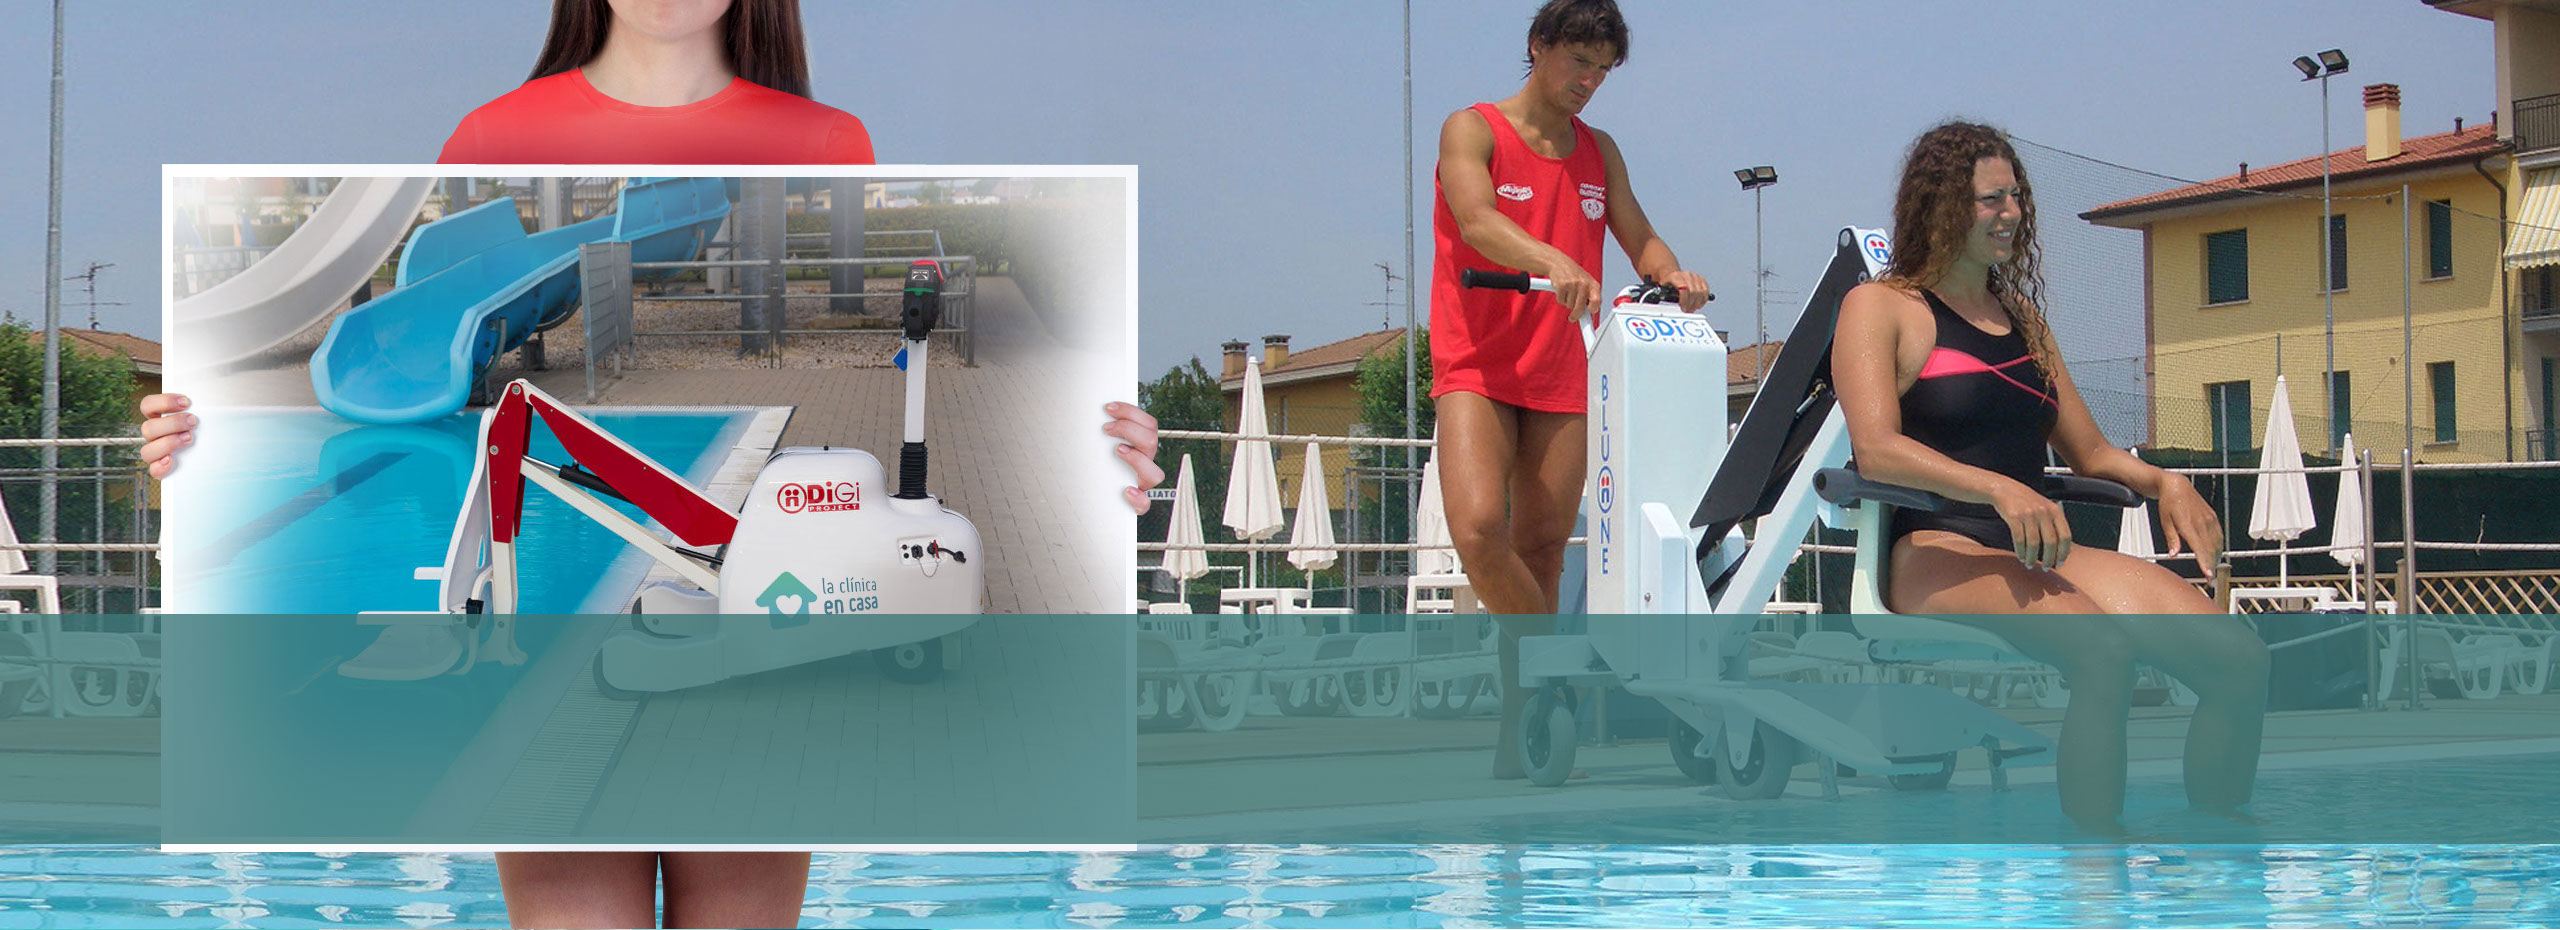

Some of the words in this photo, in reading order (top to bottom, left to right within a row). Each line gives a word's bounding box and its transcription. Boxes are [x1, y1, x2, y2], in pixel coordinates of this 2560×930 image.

[1144, 490, 1177, 498] LIATO
[808, 503, 859, 512] PROJECT
[822, 577, 834, 594] la
[839, 577, 877, 593] clínica
[824, 599, 845, 615] en
[849, 596, 878, 612] casa
